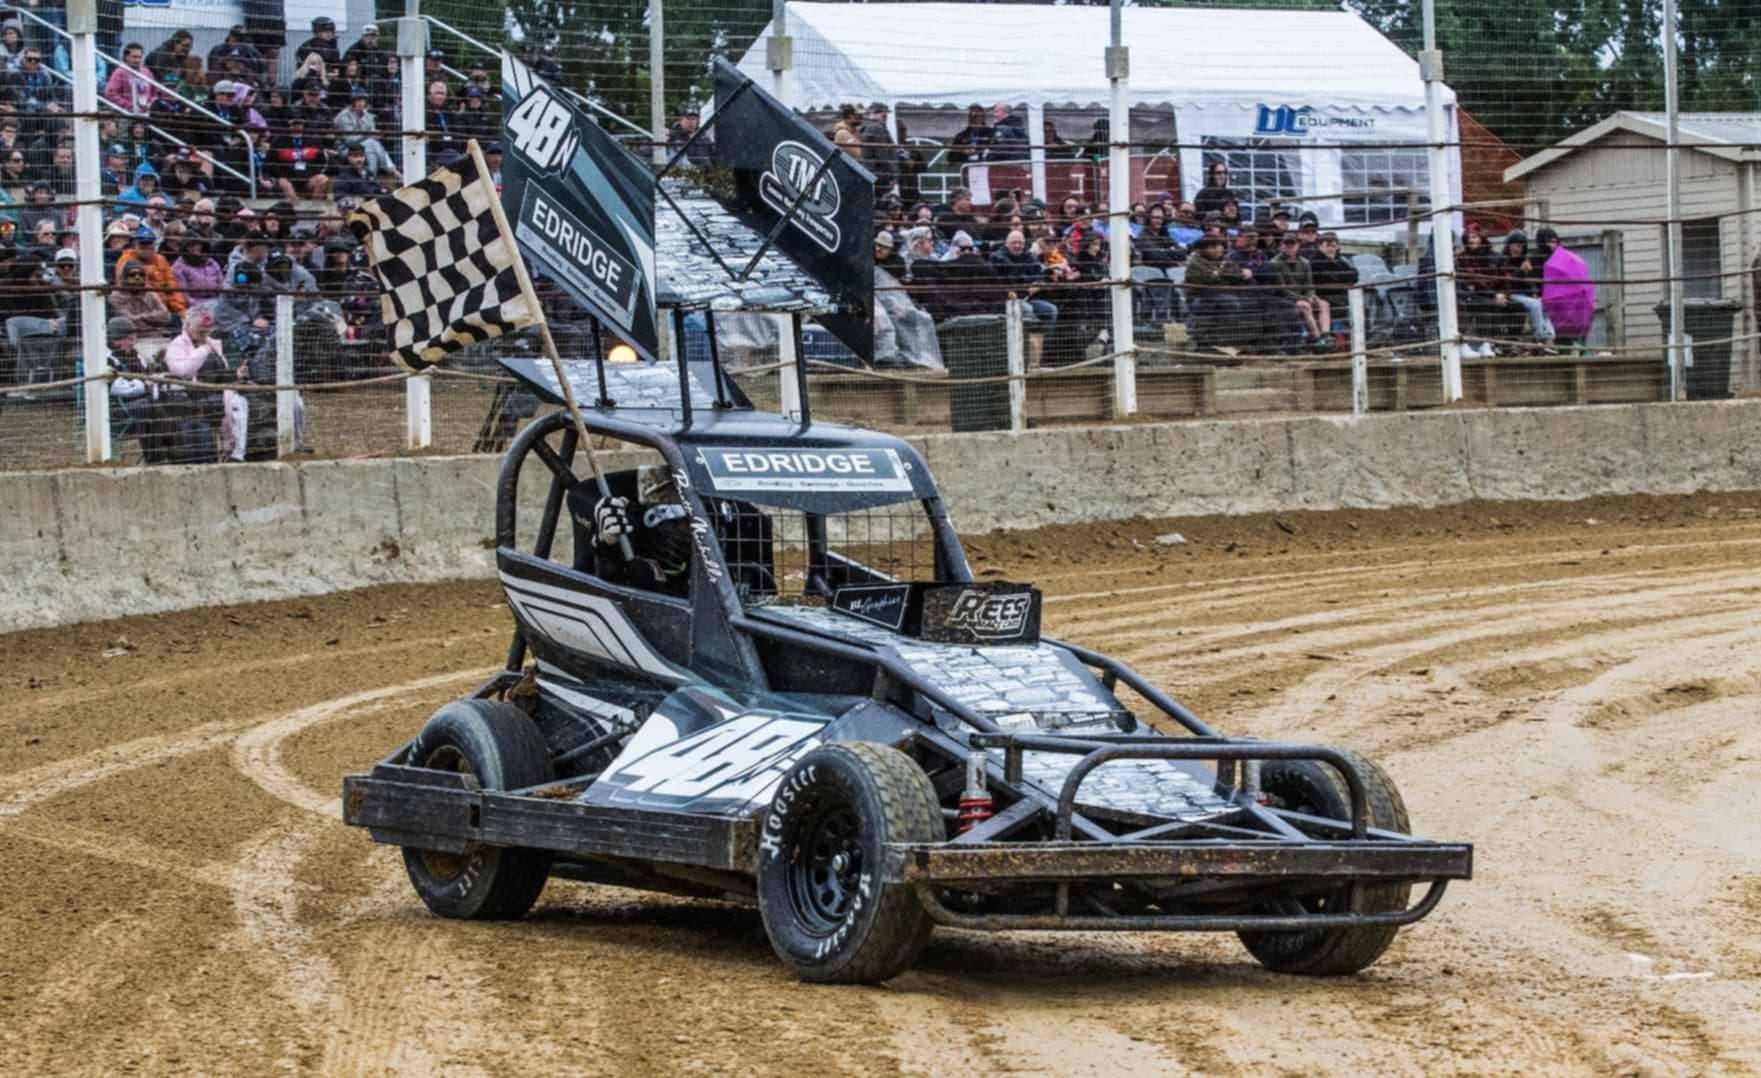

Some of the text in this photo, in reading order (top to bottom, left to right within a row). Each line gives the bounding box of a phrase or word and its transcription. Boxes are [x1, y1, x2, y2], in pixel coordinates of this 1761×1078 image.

[1299, 116, 1376, 128] EQUIPMENT
[531, 197, 622, 293] EDRIDGE
[721, 453, 876, 474] EDRIDGE
[950, 590, 1027, 622] REES
